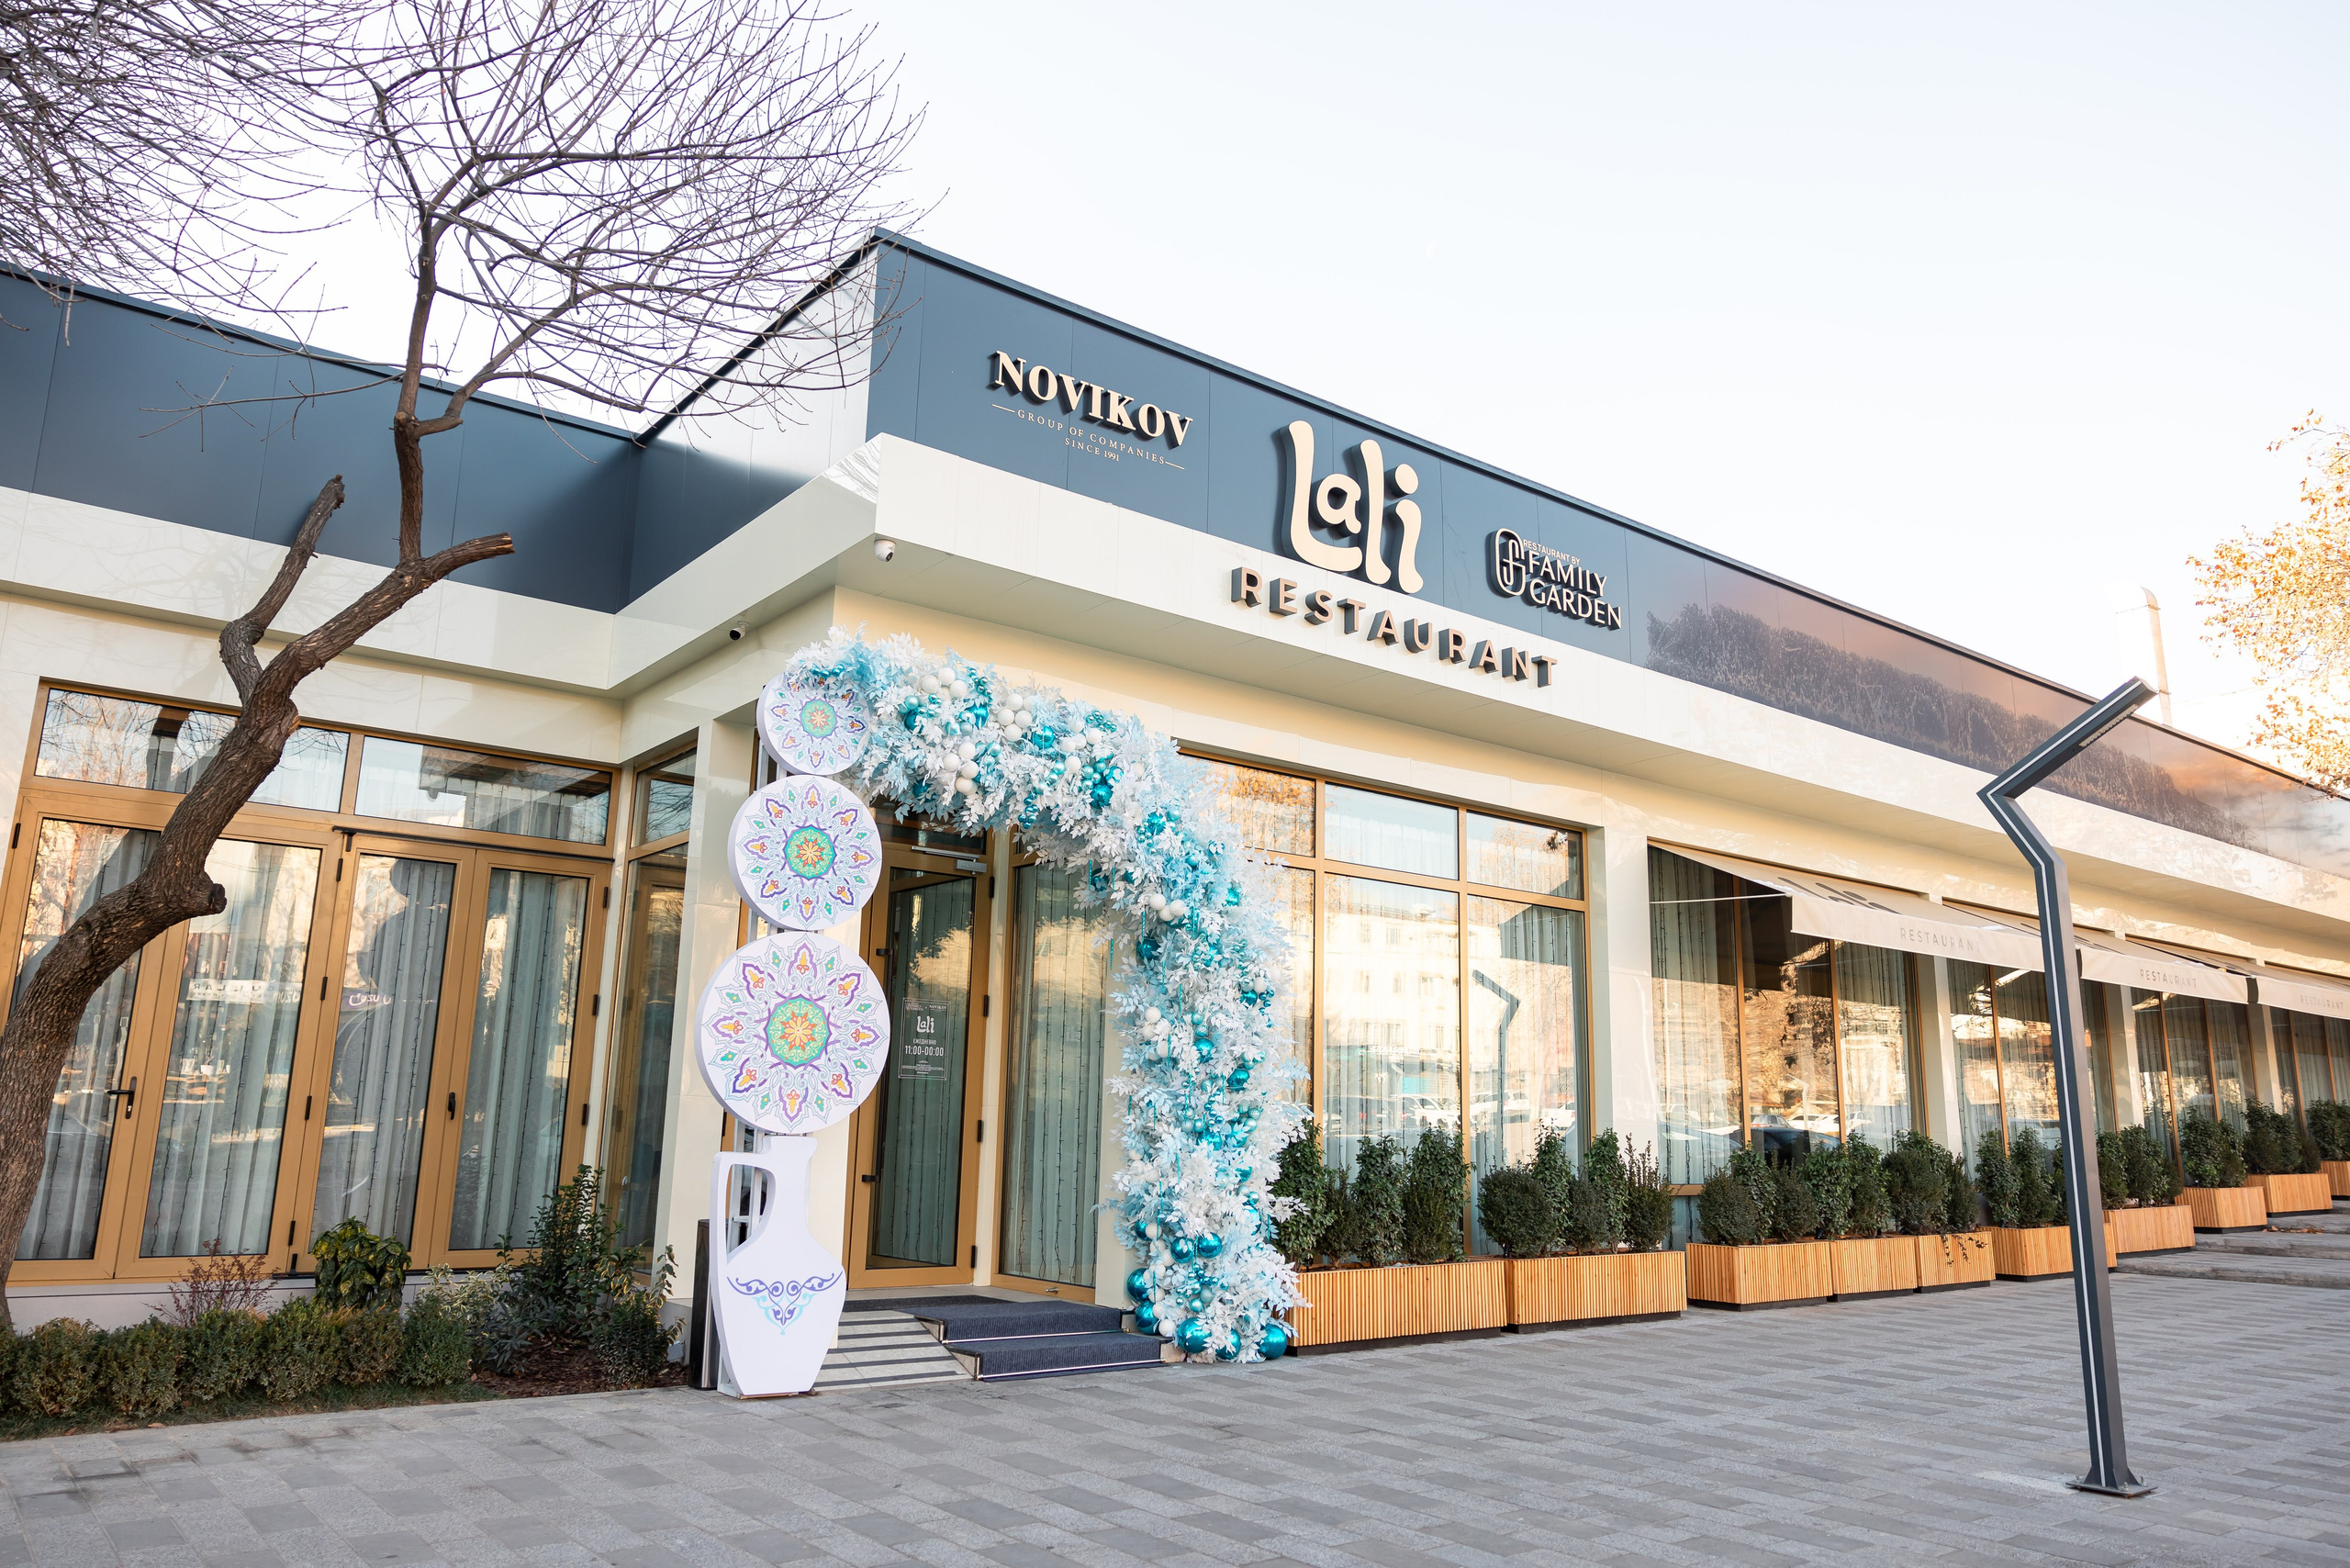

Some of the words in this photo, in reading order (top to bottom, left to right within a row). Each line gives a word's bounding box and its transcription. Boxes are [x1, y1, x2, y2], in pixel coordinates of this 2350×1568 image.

[993, 350, 1193, 447] NOVIKOV
[1017, 409, 1064, 431] GROUP
[1069, 426, 1085, 438] OF
[1090, 432, 1165, 465] COMPANIES
[1065, 437, 1101, 455] SINCE
[1103, 450, 1120, 463] 1991
[1287, 419, 1425, 595] Lali
[1523, 539, 1570, 563] RESTAURANT
[1571, 556, 1581, 566] BY
[1529, 550, 1607, 597] FAMILY
[1530, 578, 1621, 629] GARDEN
[1235, 566, 1558, 688] RESTAURANT
[1900, 927, 1981, 953] RESTAURANT
[2140, 969, 2197, 989] RESTAURANT
[2300, 994, 2344, 1011] RESTAURANT
[916, 1015, 934, 1034] Lali
[905, 1045, 944, 1057] 11:00-00:00
